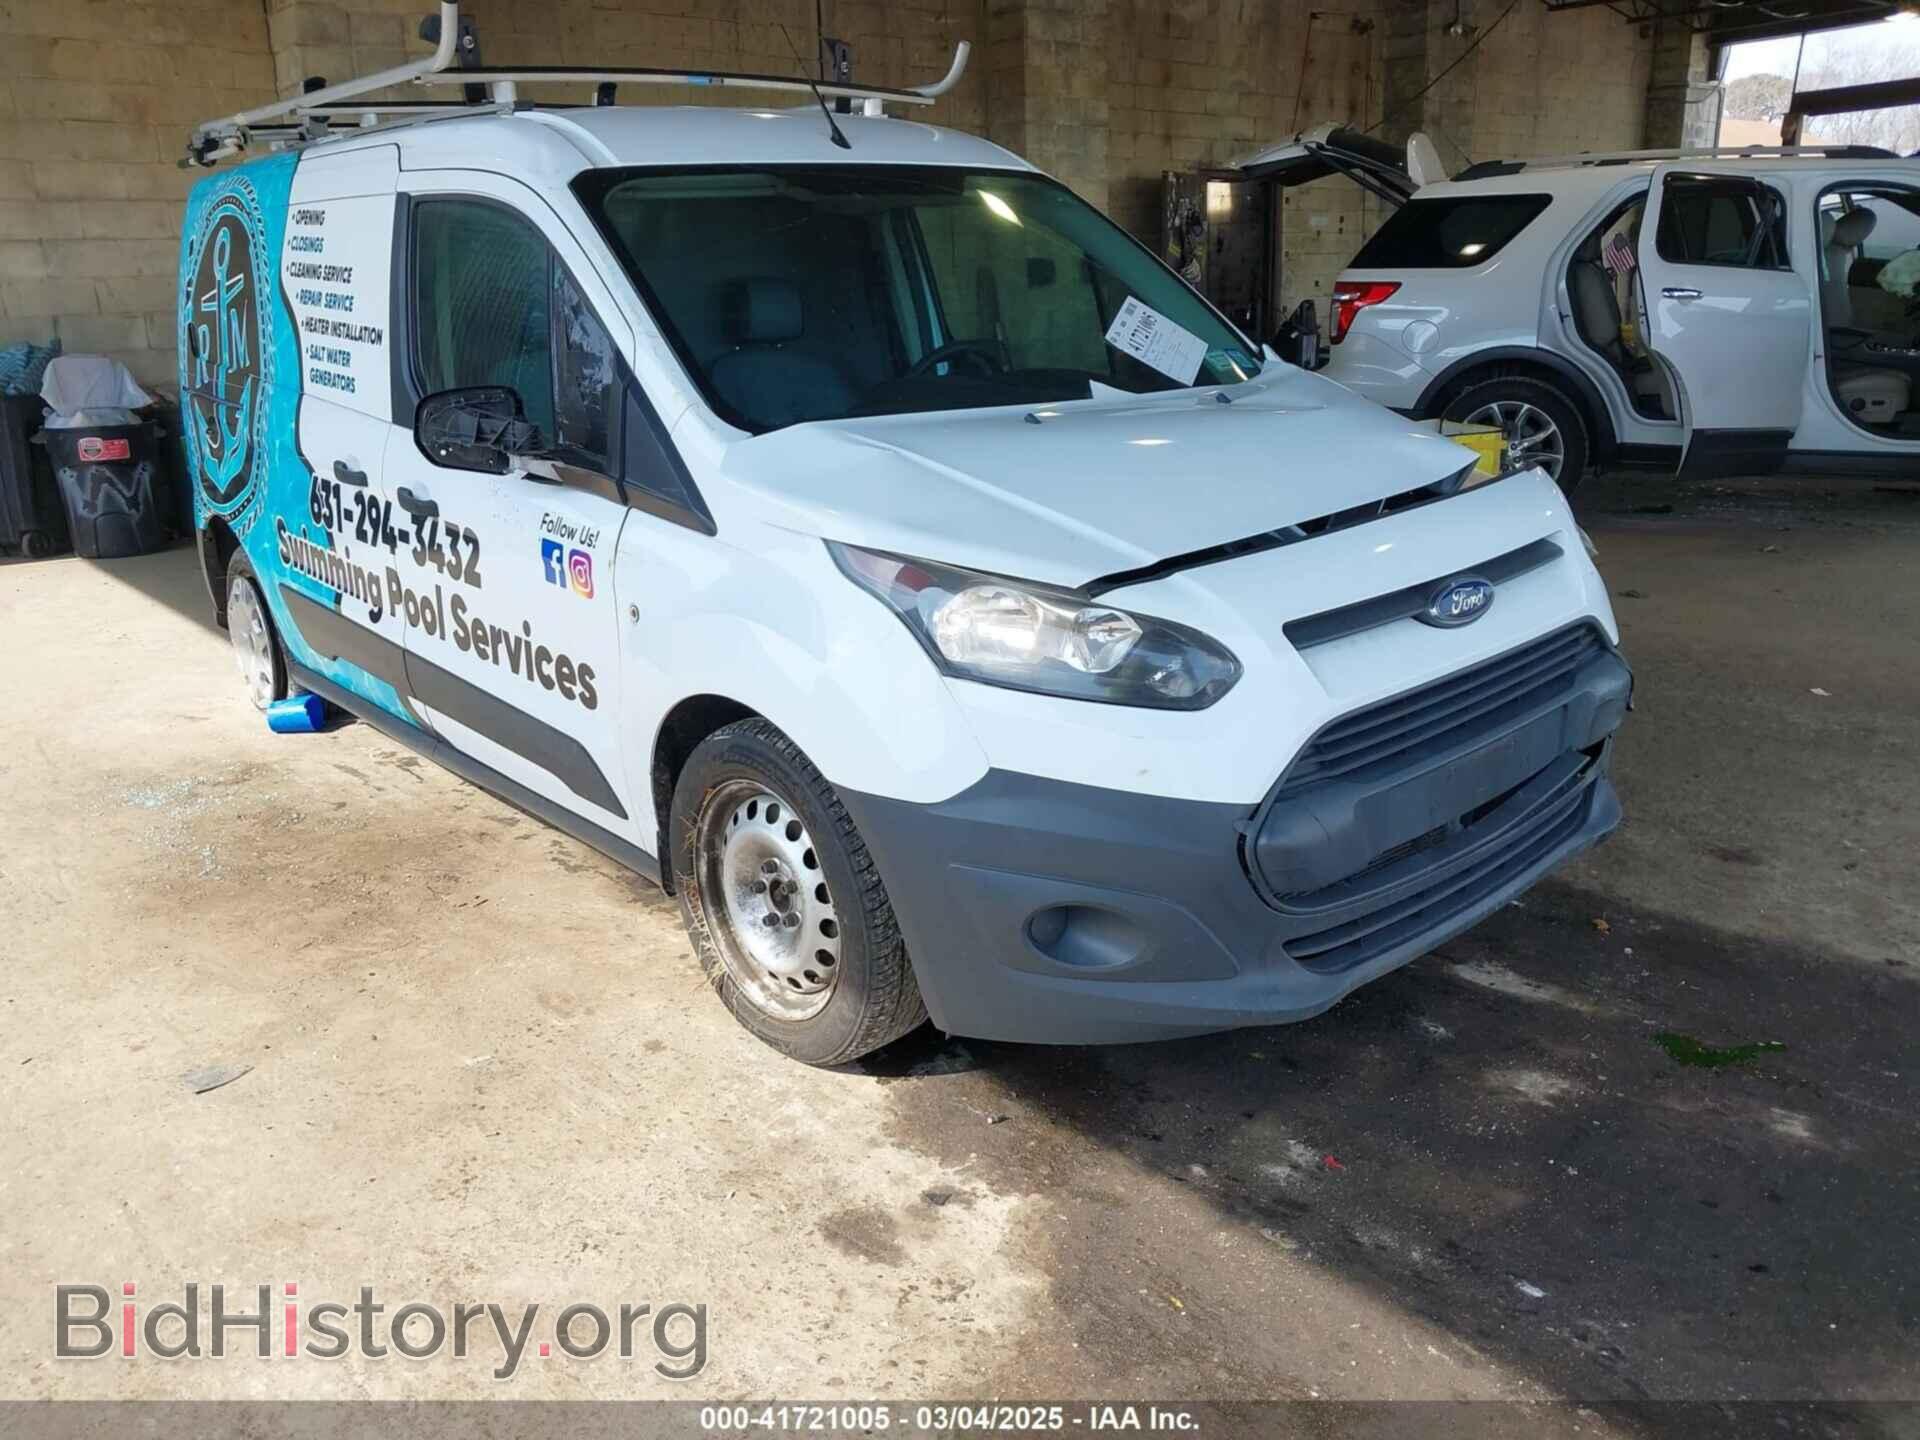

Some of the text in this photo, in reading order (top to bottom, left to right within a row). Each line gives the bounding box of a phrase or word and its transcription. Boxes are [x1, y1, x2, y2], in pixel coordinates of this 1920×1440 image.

[295, 209, 326, 227] OPENING
[290, 235, 325, 254] CLOSINGS
[289, 261, 353, 285] CLEANING SERVICE
[299, 288, 354, 313] REPAIR SERVICE
[304, 316, 384, 345] HEATER INSTALLATION
[309, 343, 351, 368] SALT WATER
[310, 367, 356, 394] GENERATORS
[310, 475, 483, 589] 631-294-3432
[540, 512, 600, 549] Follow Us!
[1451, 585, 1484, 615] Ford
[276, 517, 598, 711] Swimming Pool Services
